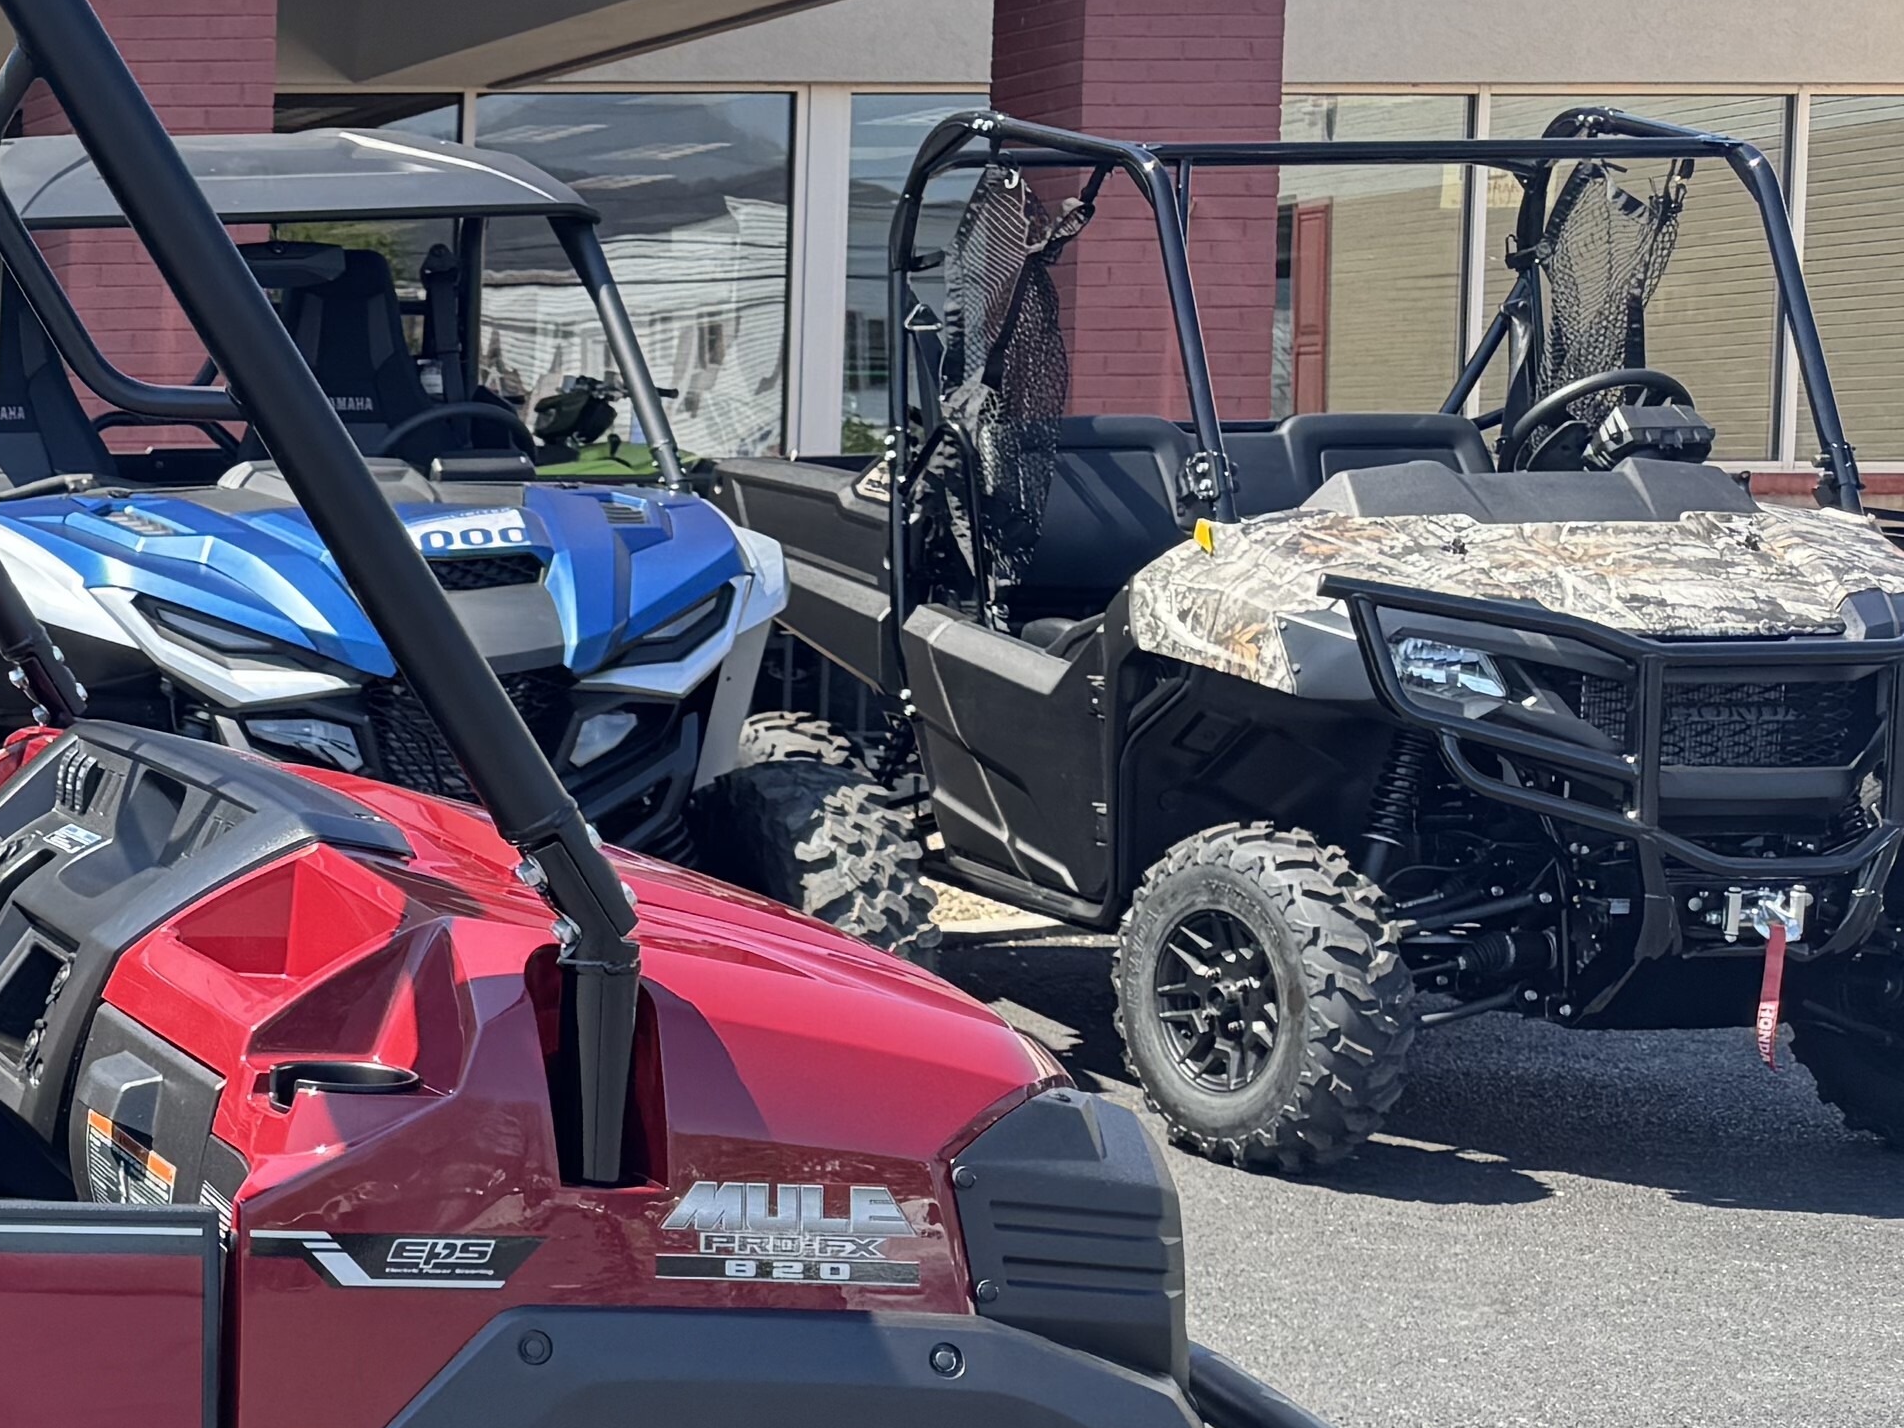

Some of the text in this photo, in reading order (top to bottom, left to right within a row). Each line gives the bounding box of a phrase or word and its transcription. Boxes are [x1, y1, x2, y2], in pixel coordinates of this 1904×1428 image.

[1757, 1004, 1776, 1063] HONDA
[661, 1181, 917, 1237] MULE
[724, 1259, 851, 1281] 820
